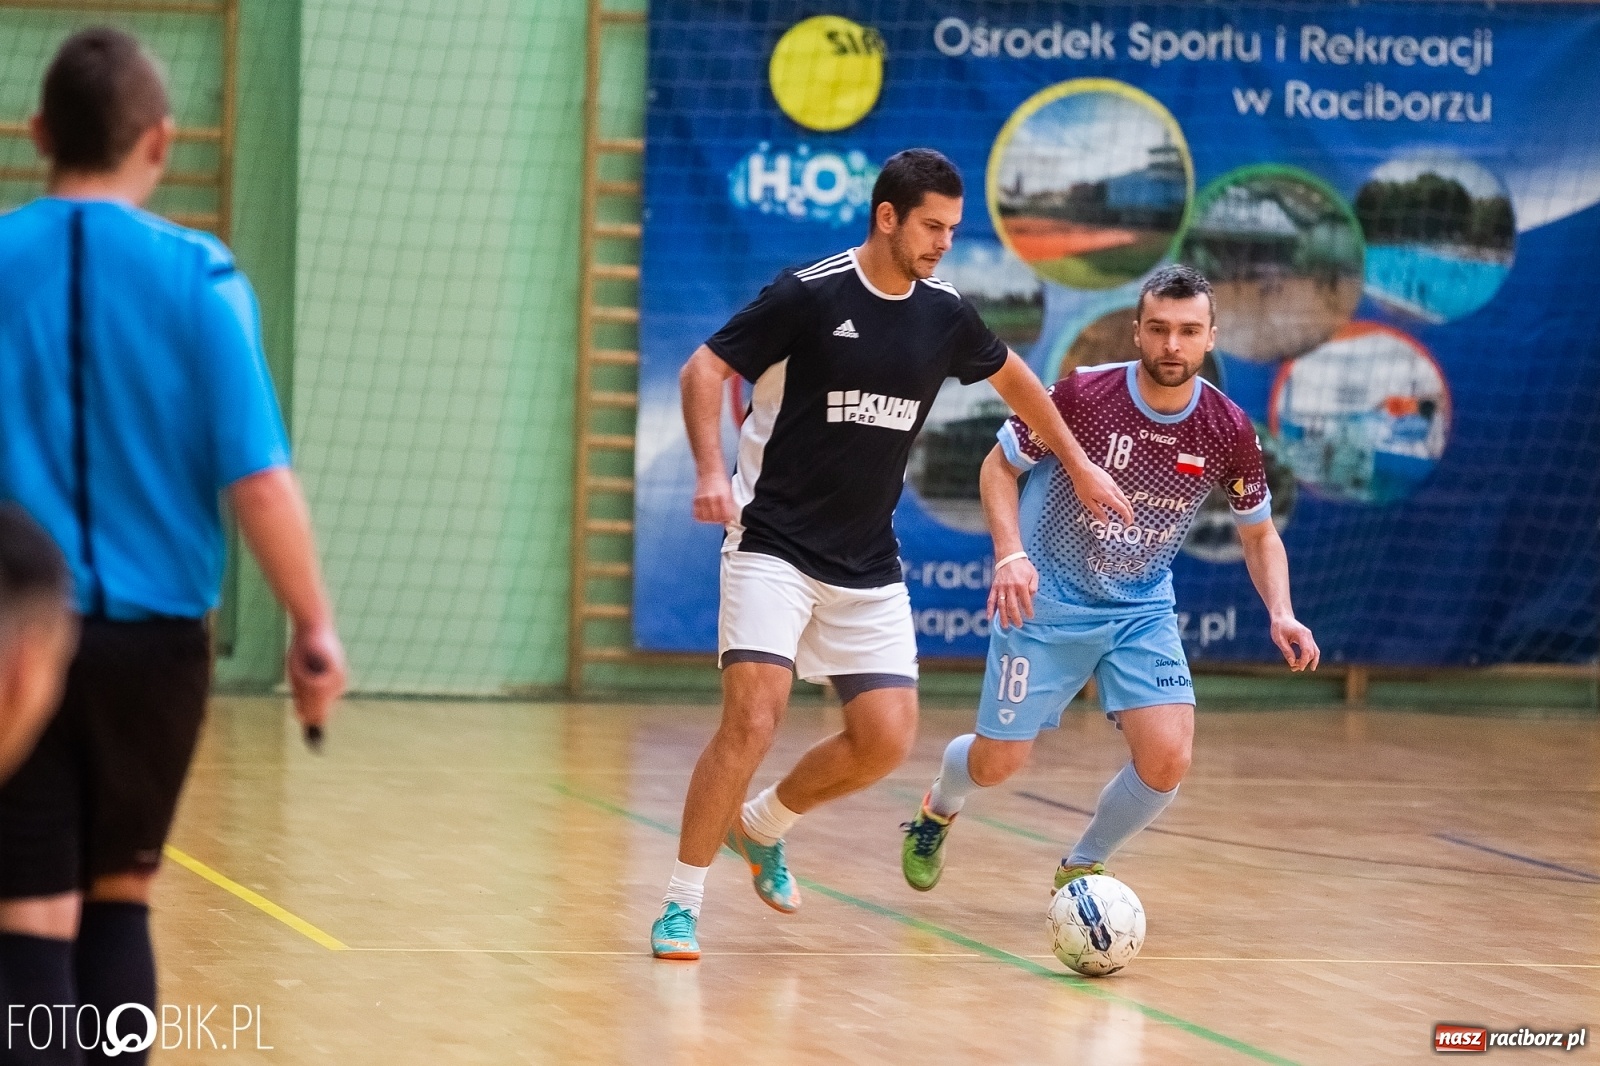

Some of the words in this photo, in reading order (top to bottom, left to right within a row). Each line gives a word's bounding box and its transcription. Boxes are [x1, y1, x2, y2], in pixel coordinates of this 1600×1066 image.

[933, 17, 1115, 60] Ośrodek
[1128, 21, 1261, 68] Sportu
[1275, 24, 1286, 63] i
[1301, 25, 1493, 75] Rekreacji
[1232, 87, 1272, 116] w
[1284, 80, 1492, 122] Raciborzu
[861, 392, 921, 420] KUHN
[1104, 432, 1134, 470] 18
[997, 654, 1030, 704] 18
